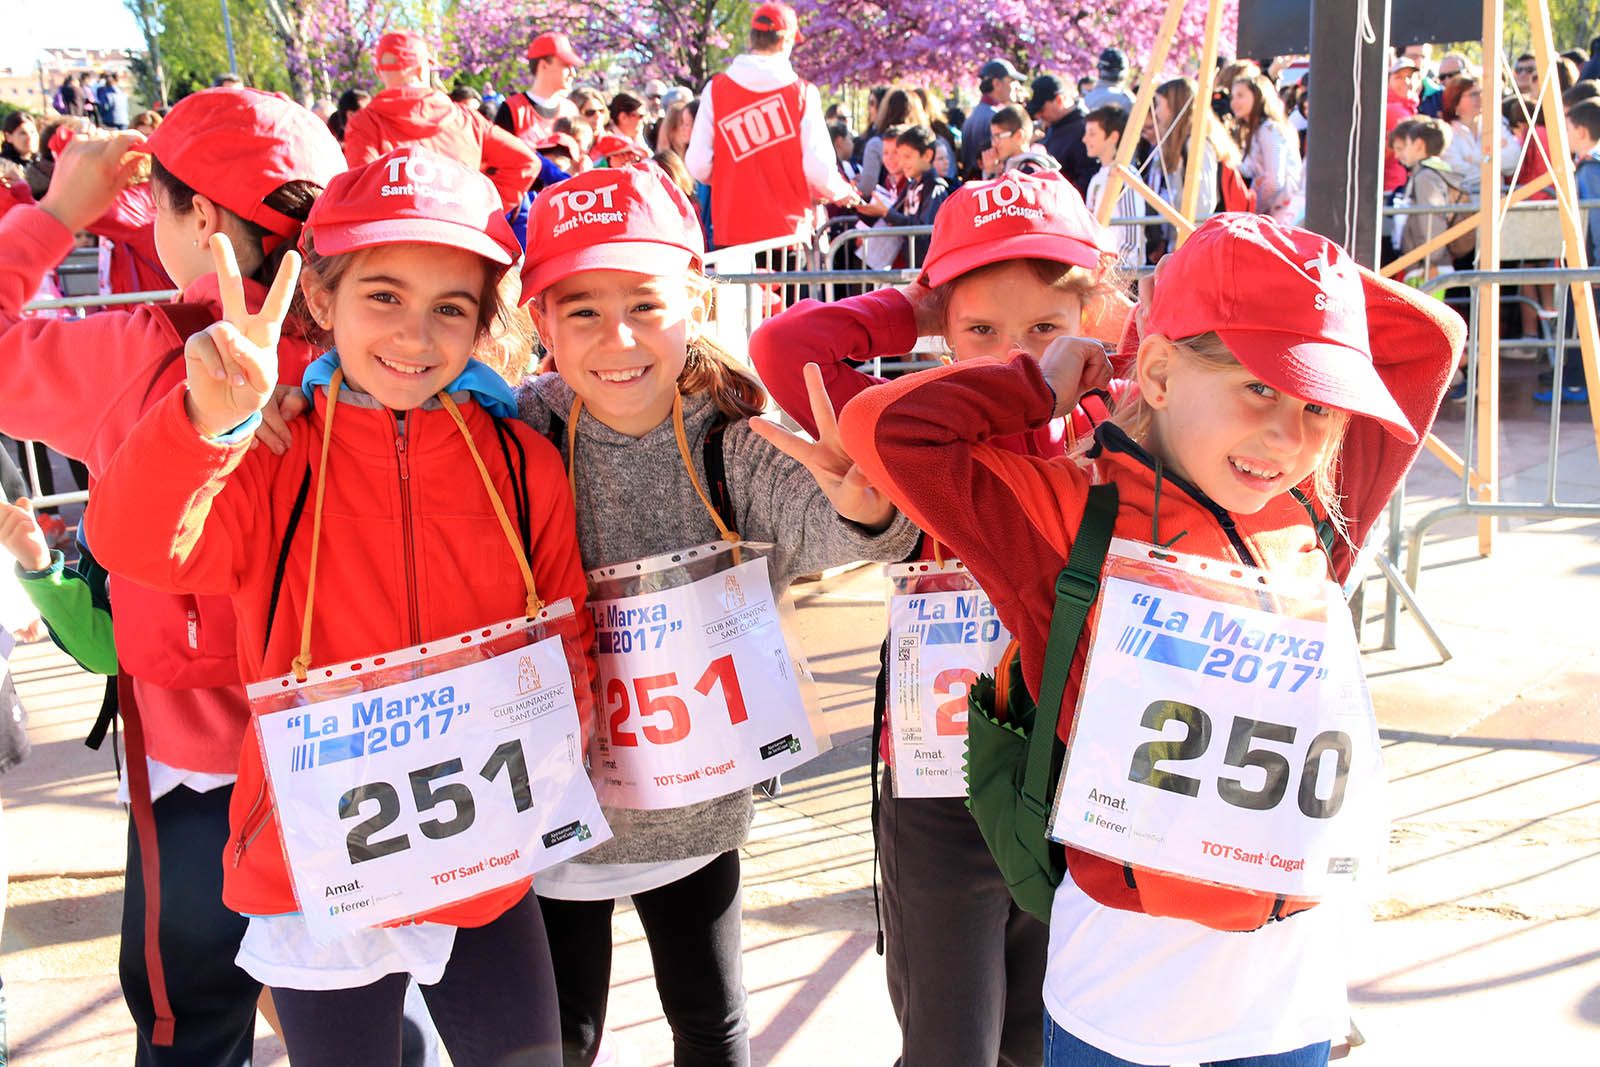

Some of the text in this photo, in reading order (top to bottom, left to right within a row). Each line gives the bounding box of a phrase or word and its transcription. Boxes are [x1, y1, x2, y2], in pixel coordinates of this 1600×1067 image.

[724, 101, 786, 153] TOT
[384, 155, 458, 189] TOT
[381, 184, 414, 197] Sant
[549, 183, 618, 222] TOT
[972, 179, 1038, 213] TOT
[553, 211, 624, 238] Sant Cugat
[974, 205, 1046, 228] Sant Cugat
[607, 603, 667, 628] Marxa
[956, 595, 996, 619] Ma
[706, 623, 725, 635] CLUB
[720, 627, 739, 640] SANT
[965, 619, 1001, 643] 20
[1200, 611, 1325, 662] Marxa
[352, 686, 455, 728] Marxa
[493, 686, 565, 718] CLUB MUNTANYENC
[510, 701, 555, 723] SANT CUGAT
[607, 653, 749, 747] 251
[933, 668, 978, 736] 2
[914, 749, 945, 760] Amat.
[1128, 700, 1353, 819] 250
[704, 759, 736, 778] Cugat
[925, 767, 949, 776] ferrer
[338, 738, 535, 865] 251
[1088, 788, 1128, 811] Amat.
[1095, 814, 1127, 834] ferrer
[488, 848, 521, 870] Cugat
[1270, 853, 1306, 873] Cugat
[325, 879, 364, 898] Amat.
[340, 898, 370, 913] ferrer
